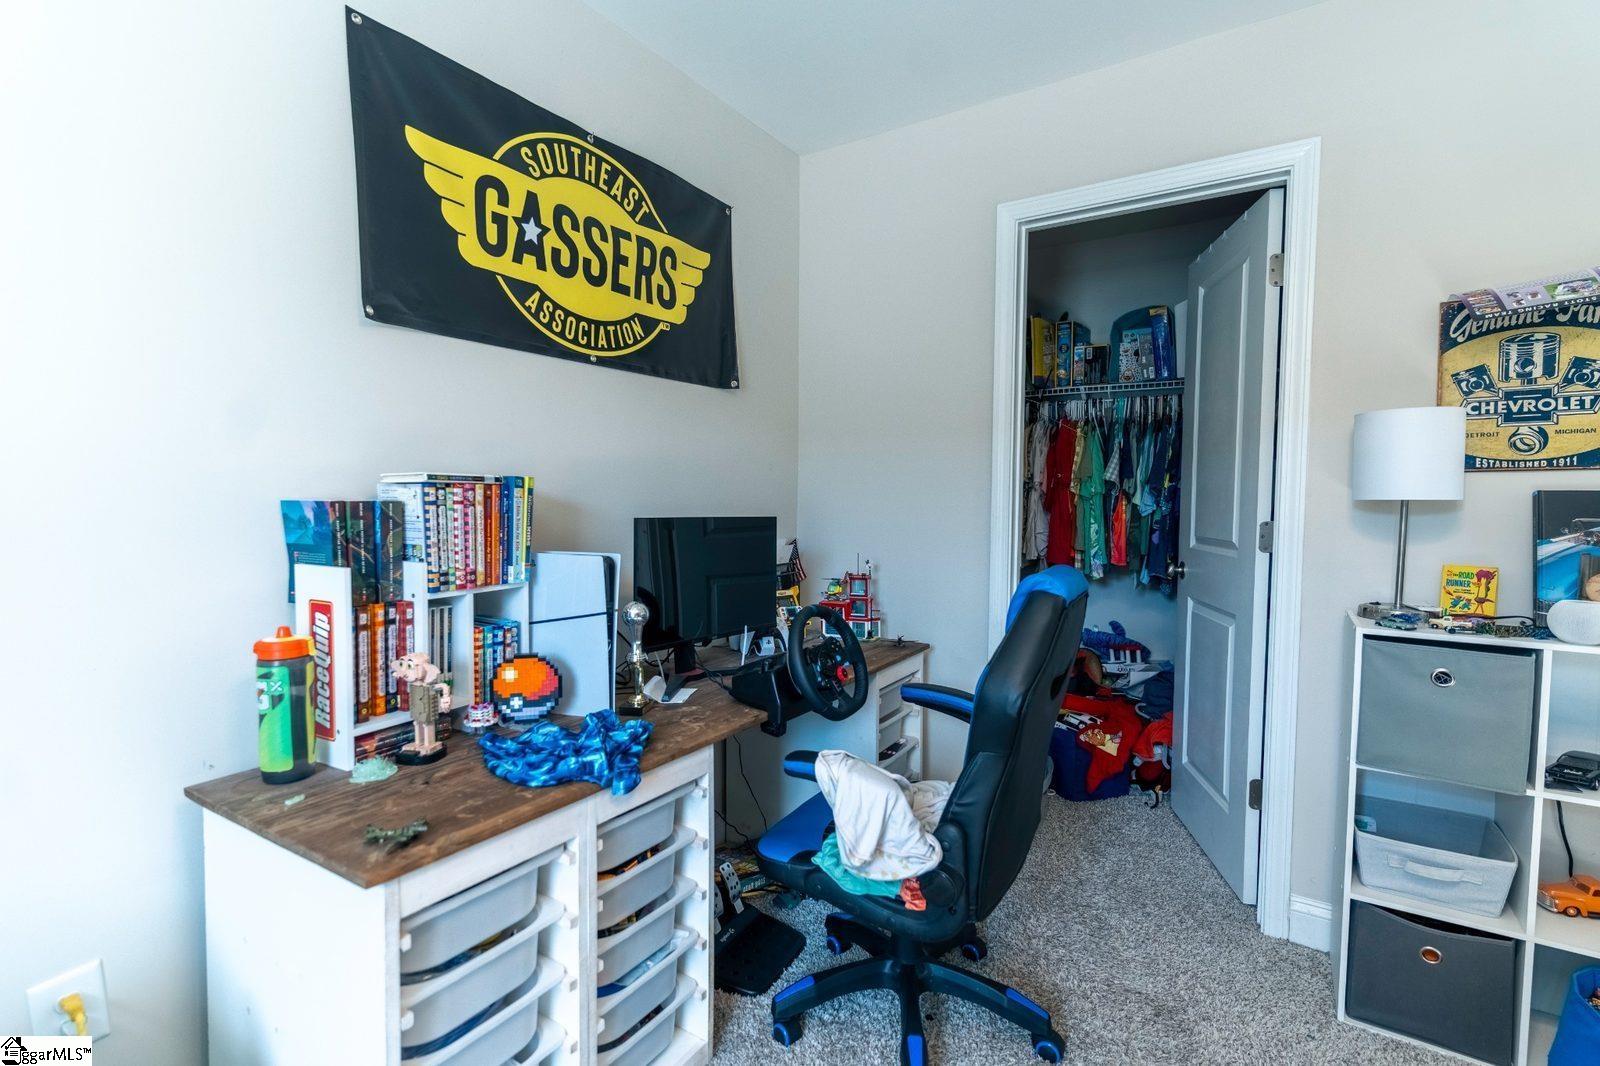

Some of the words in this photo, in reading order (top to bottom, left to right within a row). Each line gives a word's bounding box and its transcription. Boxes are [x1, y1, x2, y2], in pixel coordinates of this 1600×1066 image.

[520, 143, 652, 224] SOUTHEAST
[473, 173, 678, 310] GASSERS
[1517, 301, 1559, 313] RACING
[524, 290, 646, 352] ASSOCIATION
[1466, 395, 1595, 416] CHEVROLET
[1554, 427, 1597, 435] MICHIGAN
[1475, 457, 1547, 468] ESTABLISHED
[1552, 455, 1578, 467] 1911
[1446, 578, 1471, 588] RUNNER
[1458, 571, 1475, 580] ROAD
[313, 611, 331, 729] RaceQuip
